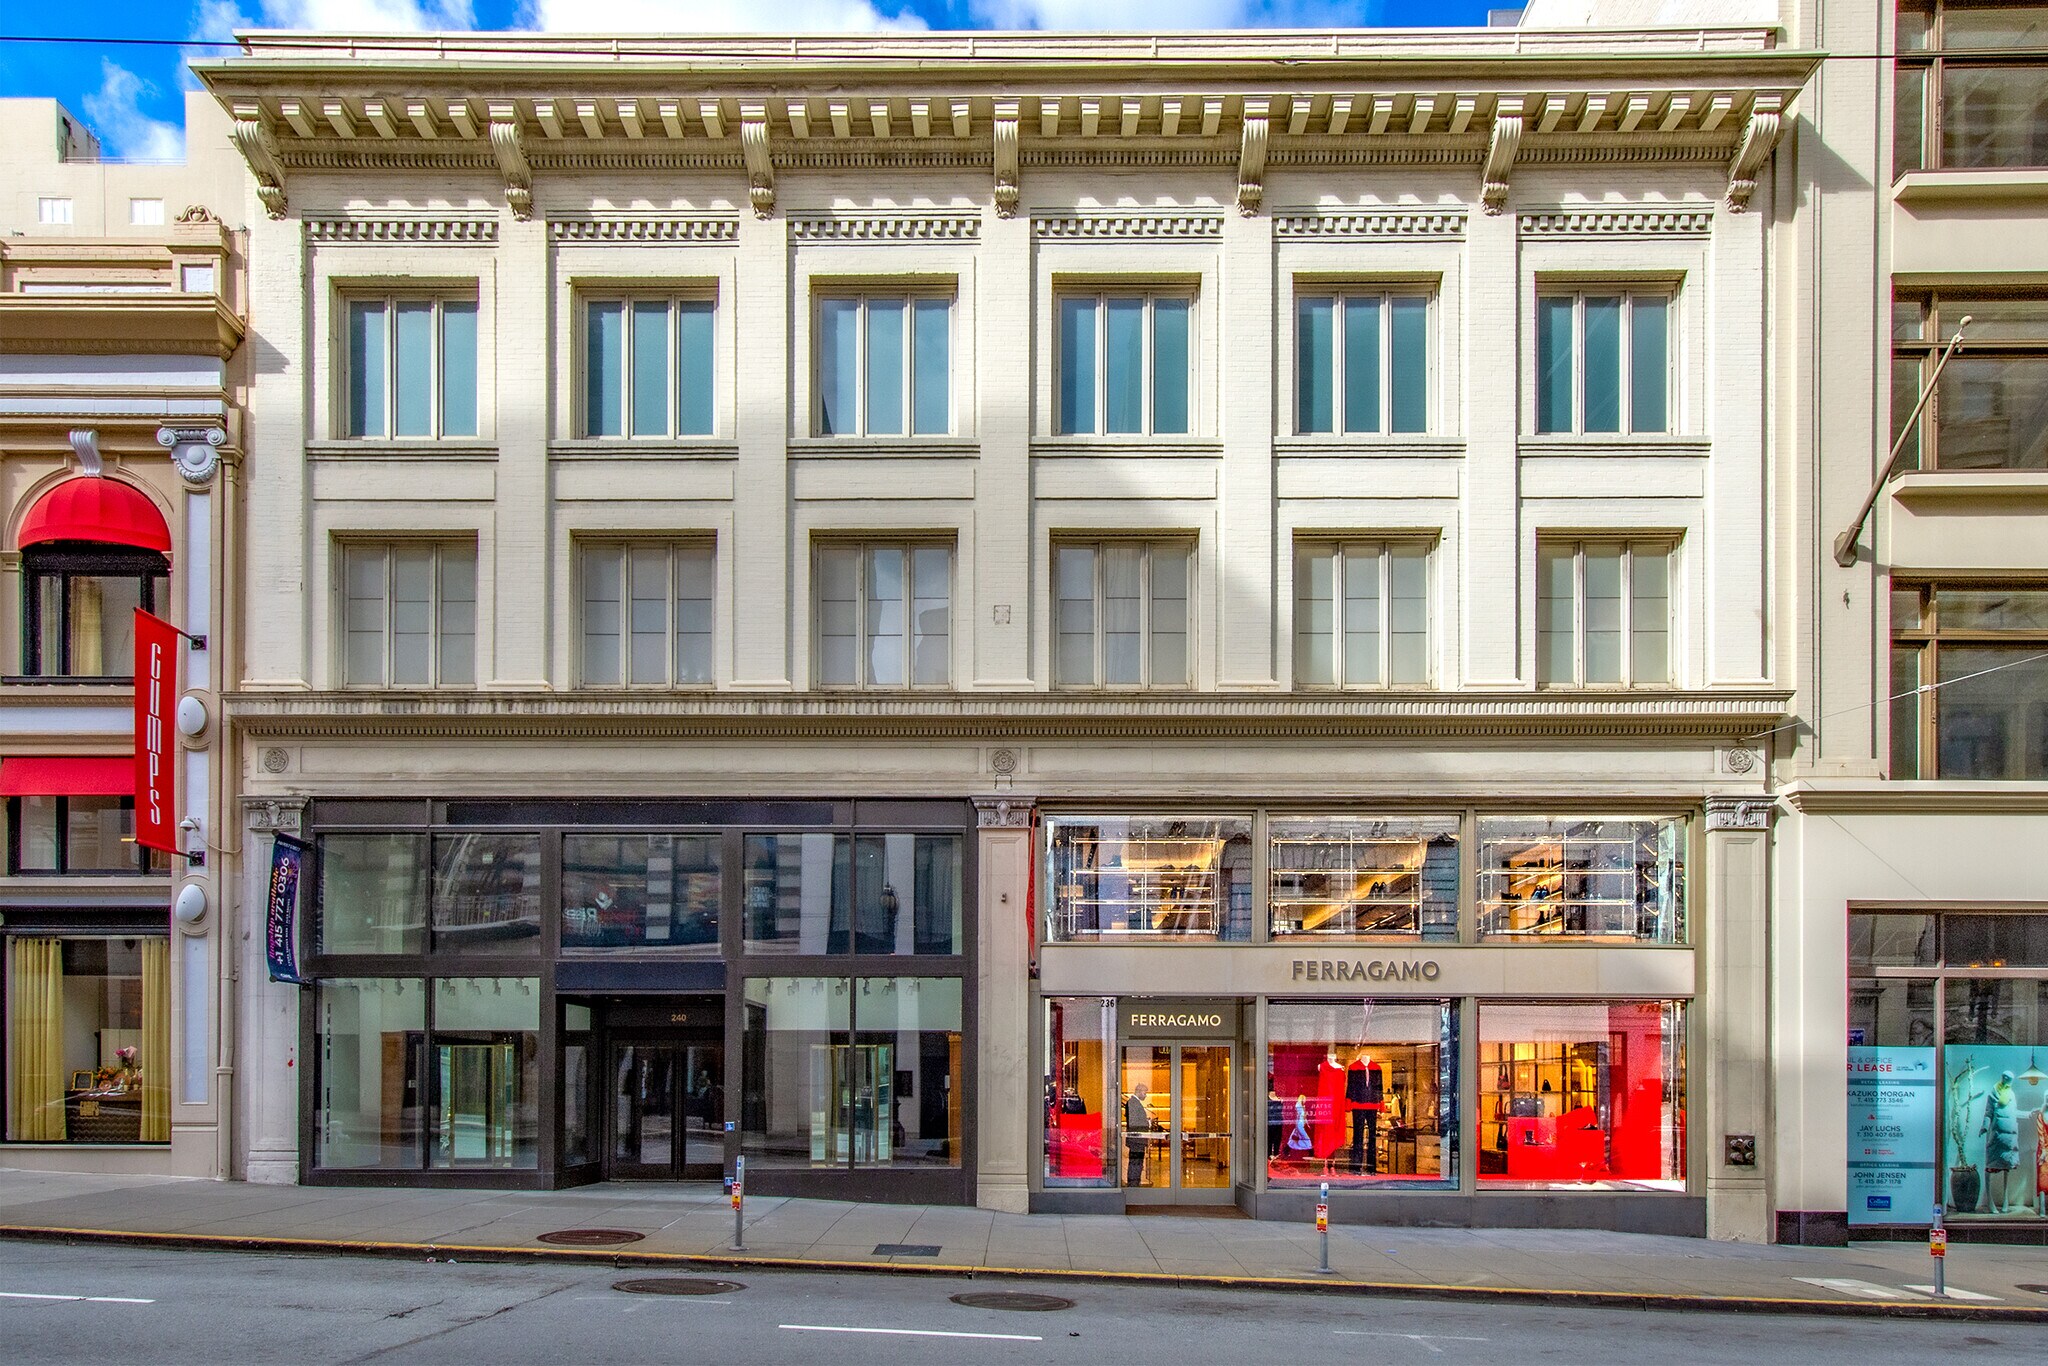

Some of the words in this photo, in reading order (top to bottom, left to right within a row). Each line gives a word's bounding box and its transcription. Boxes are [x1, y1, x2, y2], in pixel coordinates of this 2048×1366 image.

[277, 857, 290, 893] 0306
[275, 898, 285, 922] 772
[274, 925, 284, 947] 415
[1292, 960, 1440, 981] FERRAGAMO
[1101, 999, 1115, 1008] 236
[1131, 1014, 1221, 1026] FERRAGAMO
[1857, 1064, 1893, 1072] LEASE
